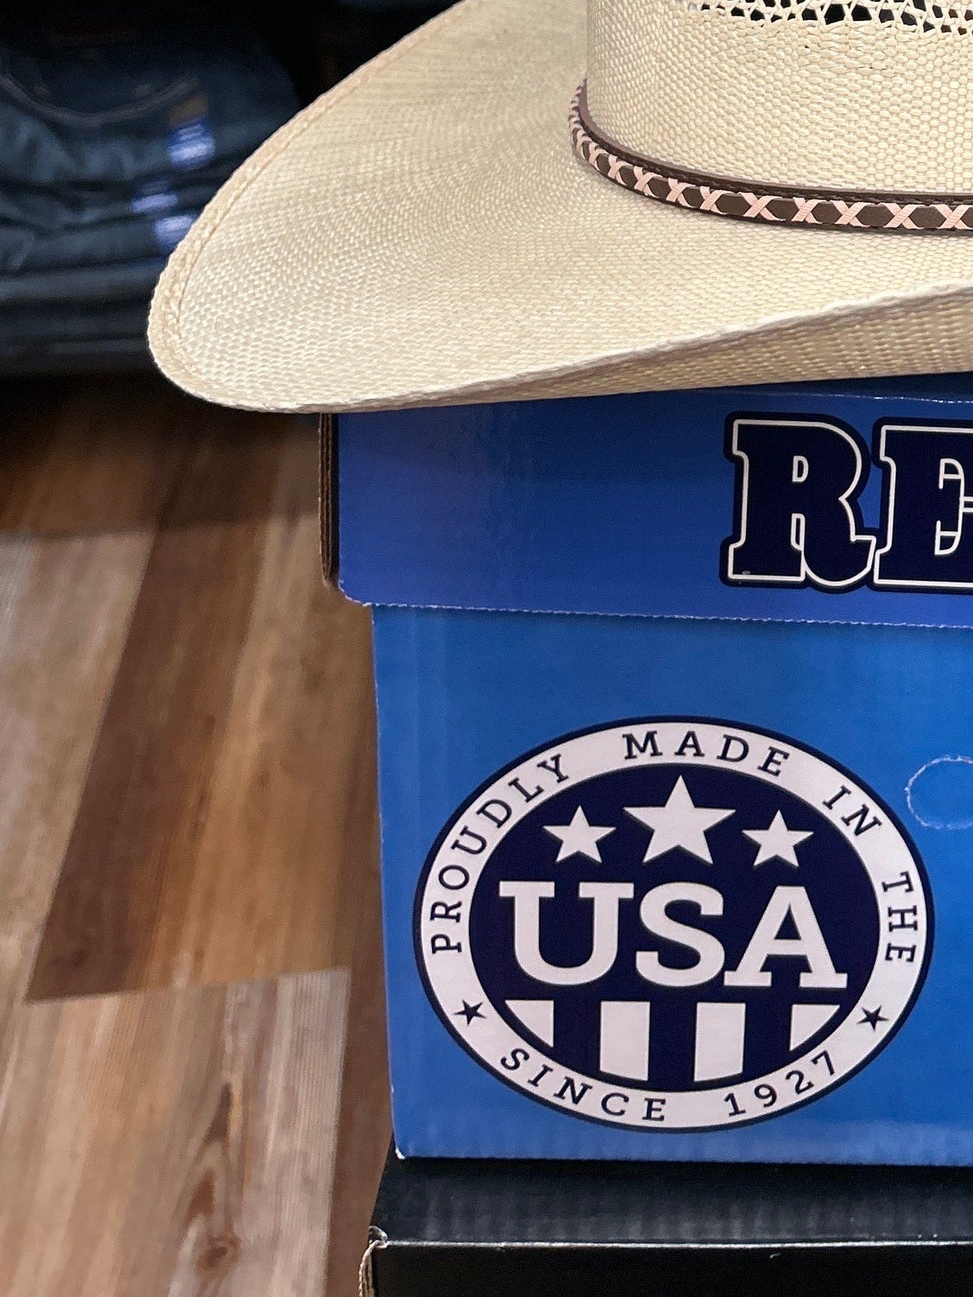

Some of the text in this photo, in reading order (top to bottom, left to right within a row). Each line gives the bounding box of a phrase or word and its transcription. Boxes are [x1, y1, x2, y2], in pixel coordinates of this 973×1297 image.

[430, 730, 918, 964] PROUDLY MADE IN THE
[499, 880, 848, 989] USA
[500, 1047, 837, 1123] SINCE 1927
